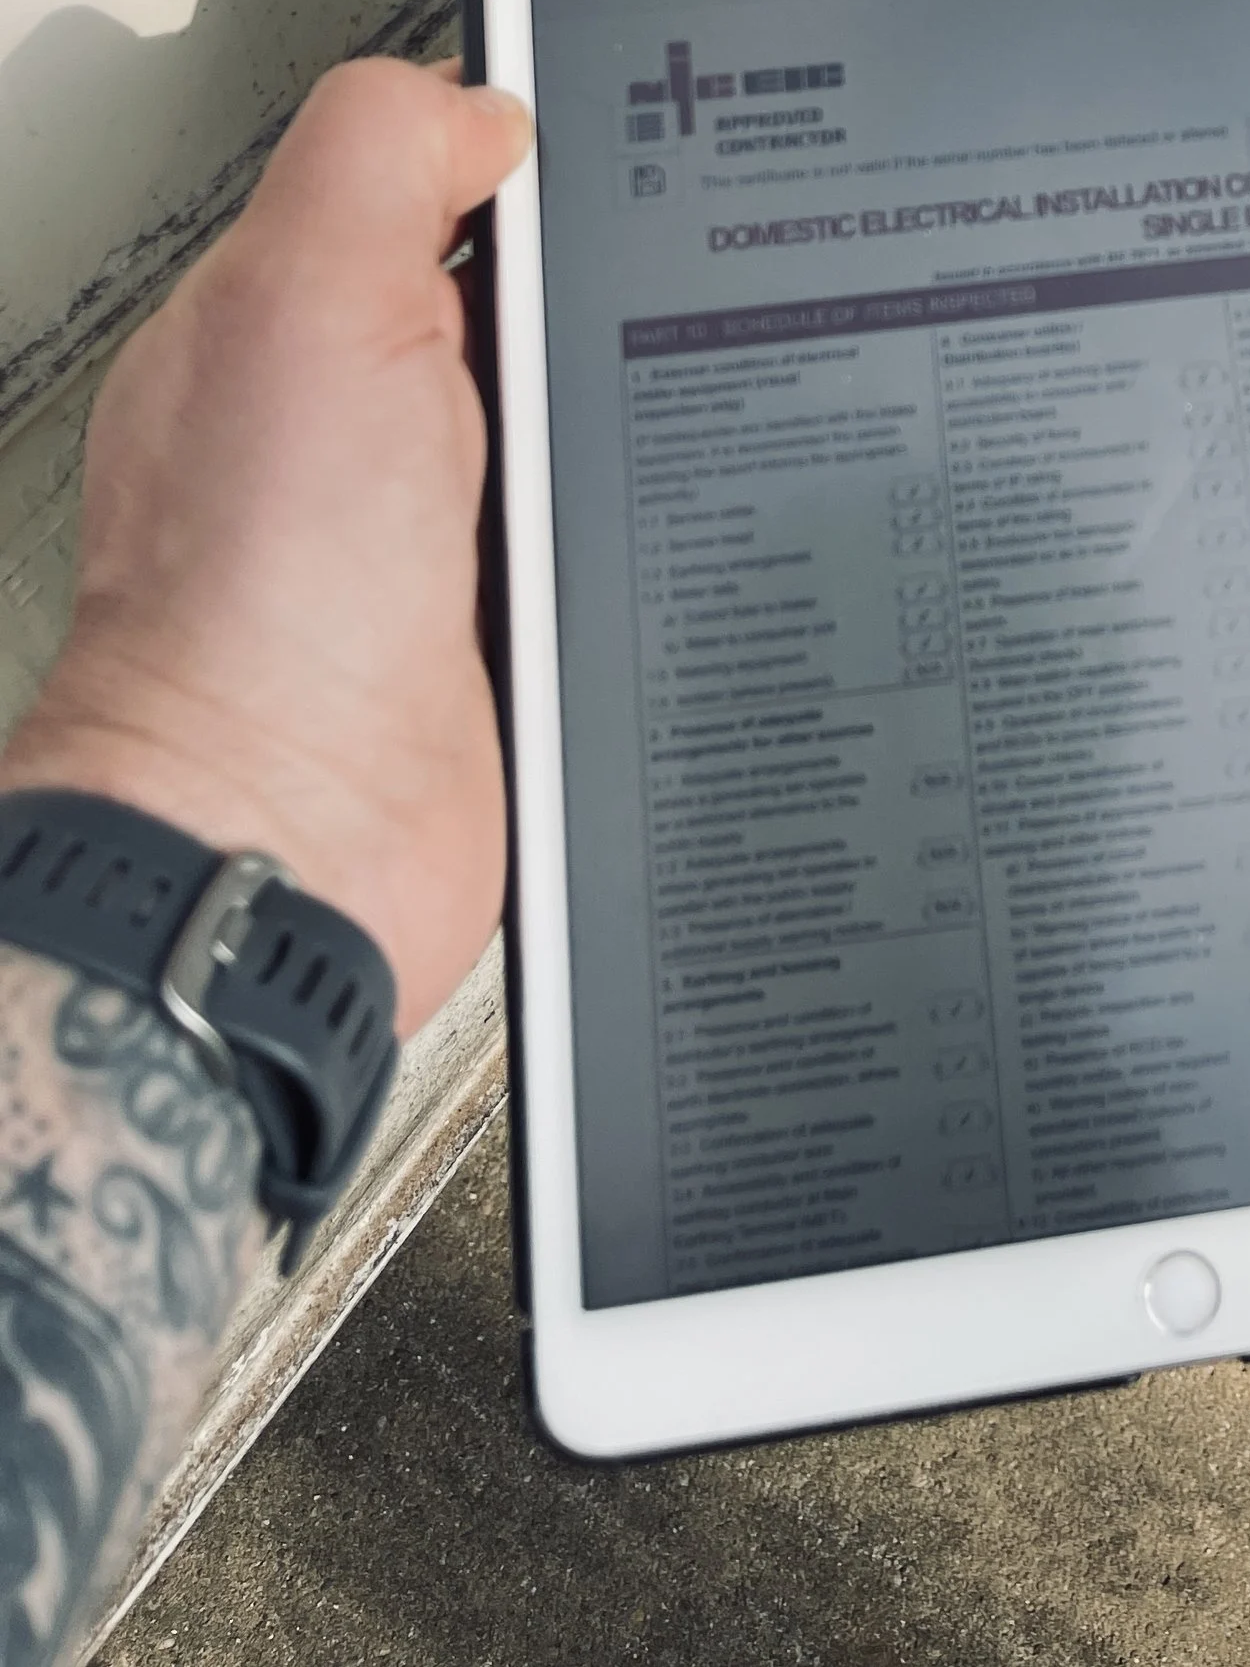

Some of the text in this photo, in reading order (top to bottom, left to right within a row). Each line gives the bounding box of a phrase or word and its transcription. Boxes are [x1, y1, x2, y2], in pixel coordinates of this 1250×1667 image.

[707, 212, 856, 253] DOMESTIC
[858, 194, 1025, 238] ELECTRICAL
[1032, 174, 1222, 221] INSTALLATION
[1142, 204, 1240, 240] SINGLE
